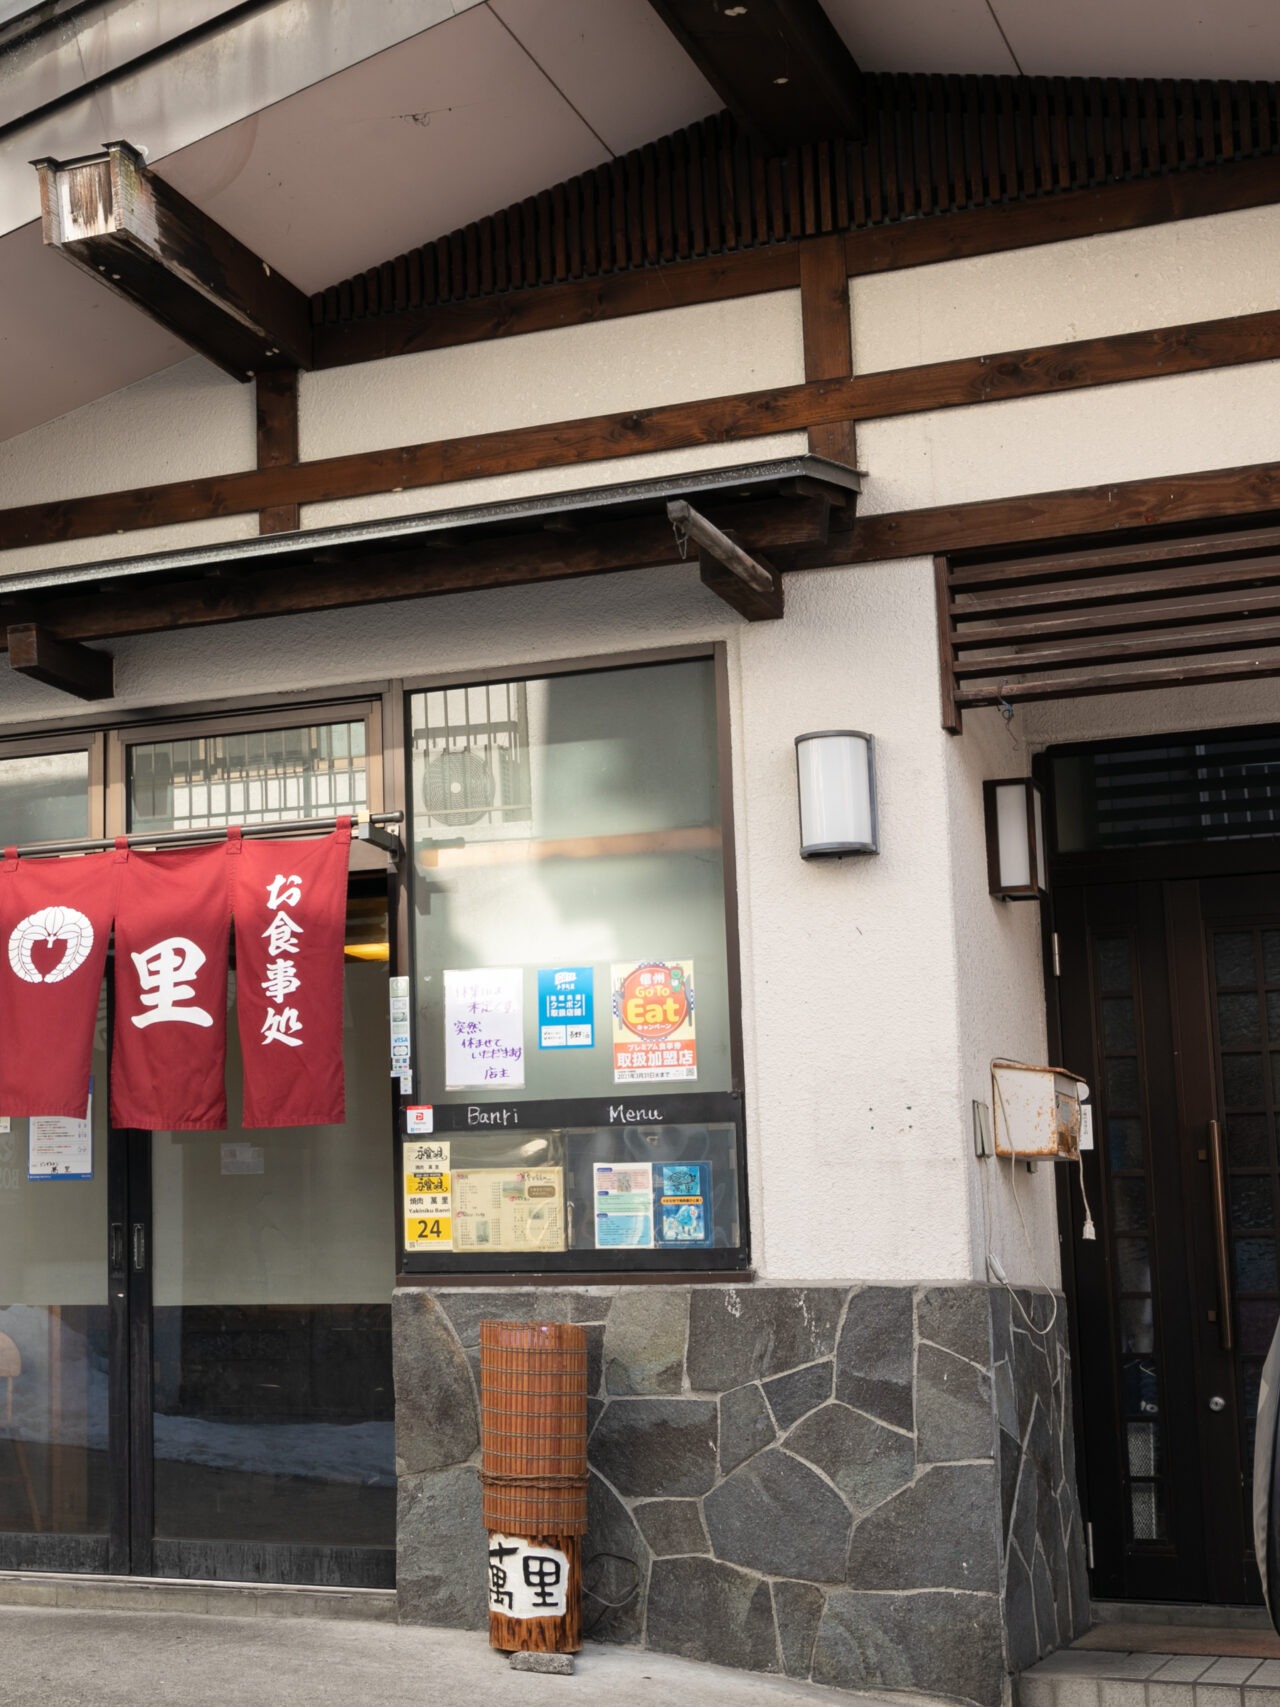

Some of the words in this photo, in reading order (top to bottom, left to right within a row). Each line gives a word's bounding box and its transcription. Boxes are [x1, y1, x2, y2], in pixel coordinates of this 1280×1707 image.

[261, 874, 304, 1047] お食事処
[131, 937, 214, 1029] 里
[550, 1001, 582, 1009] クーポン
[626, 997, 680, 1024] Eat
[617, 1050, 694, 1067] 取扱加盟店
[467, 1107, 519, 1125] Banri
[609, 1105, 664, 1123] Menu
[417, 1219, 442, 1239] 24
